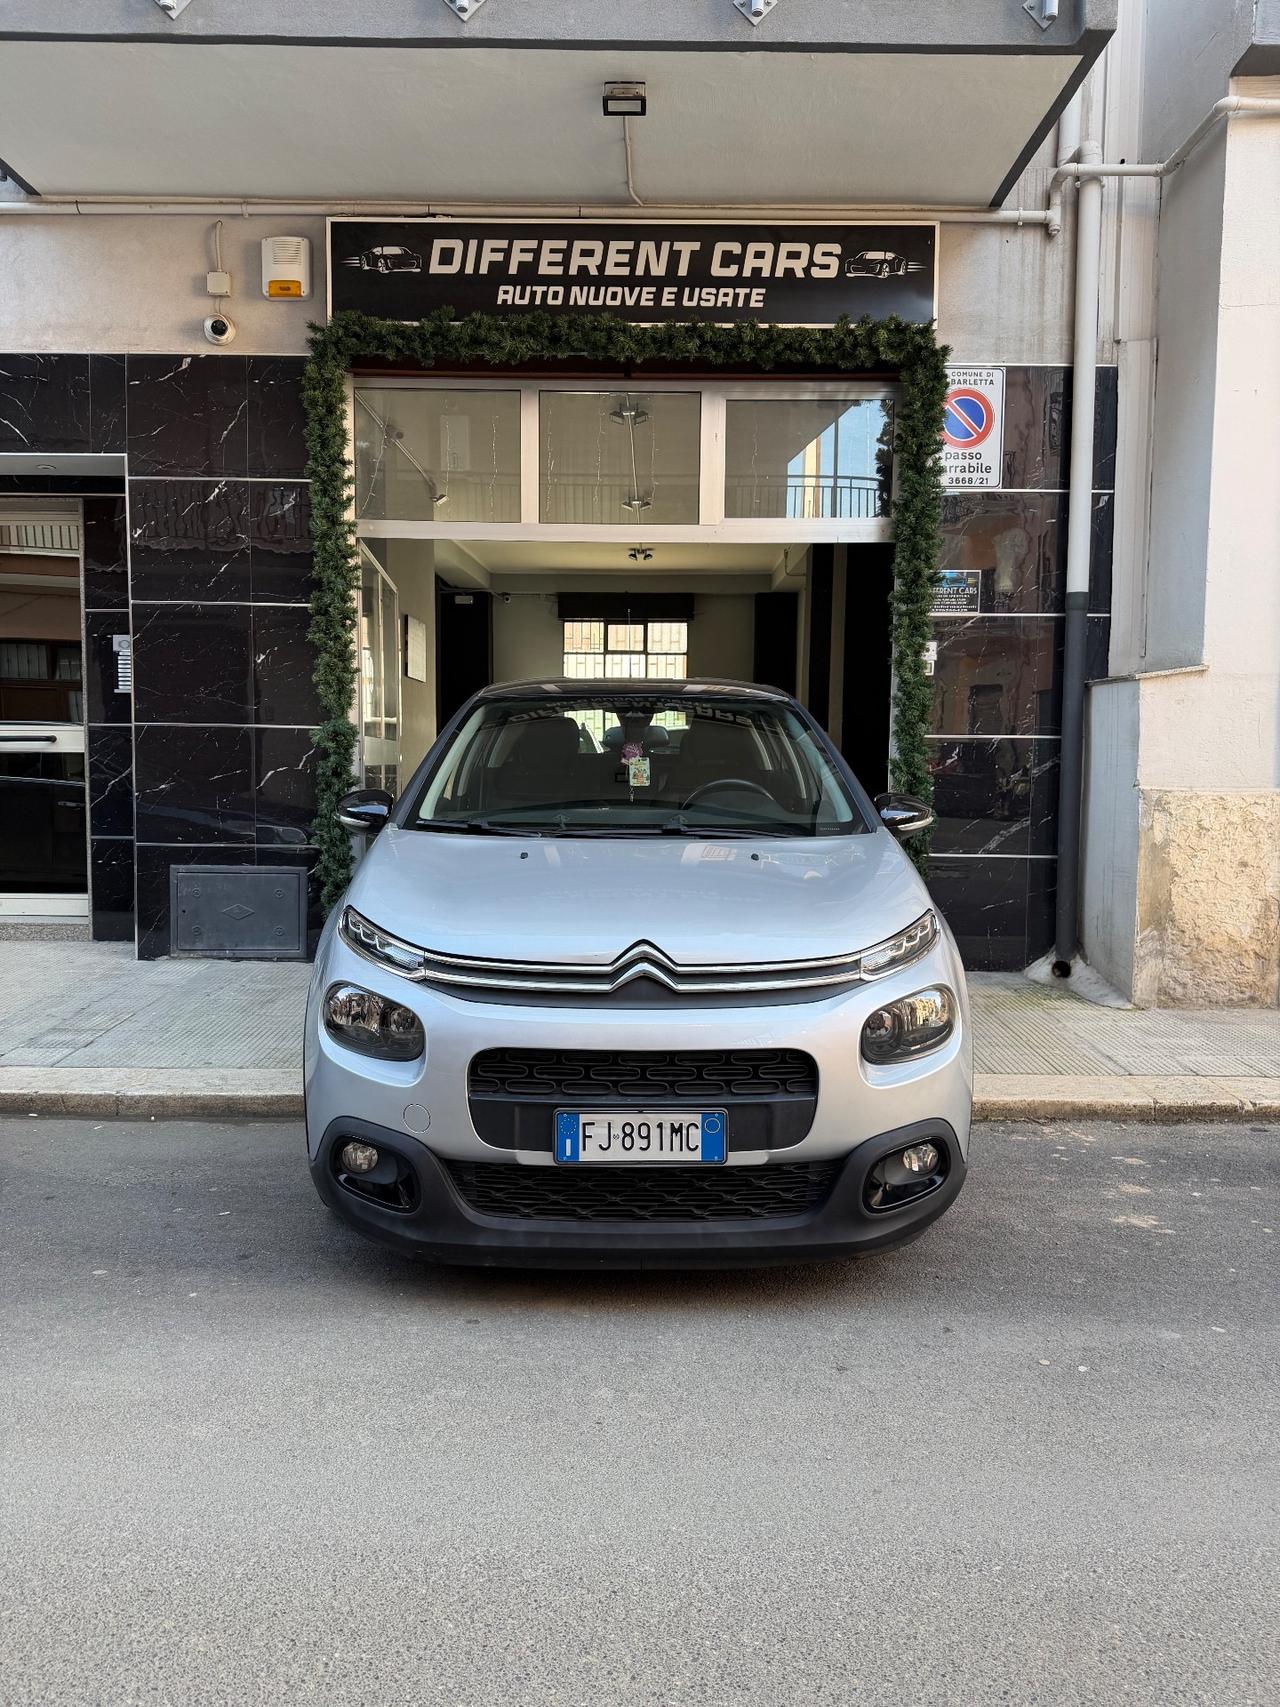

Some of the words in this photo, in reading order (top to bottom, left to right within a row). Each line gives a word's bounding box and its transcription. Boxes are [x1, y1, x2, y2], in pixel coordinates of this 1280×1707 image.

[429, 239, 701, 276] DIFFERENT
[710, 242, 842, 278] CARS
[497, 285, 564, 305] AUTO
[569, 286, 657, 306] NUOVE
[661, 287, 678, 306] E
[682, 287, 766, 308] USATE
[945, 451, 982, 461] passo
[946, 462, 992, 474] rrabile
[948, 476, 989, 485] 3668/21
